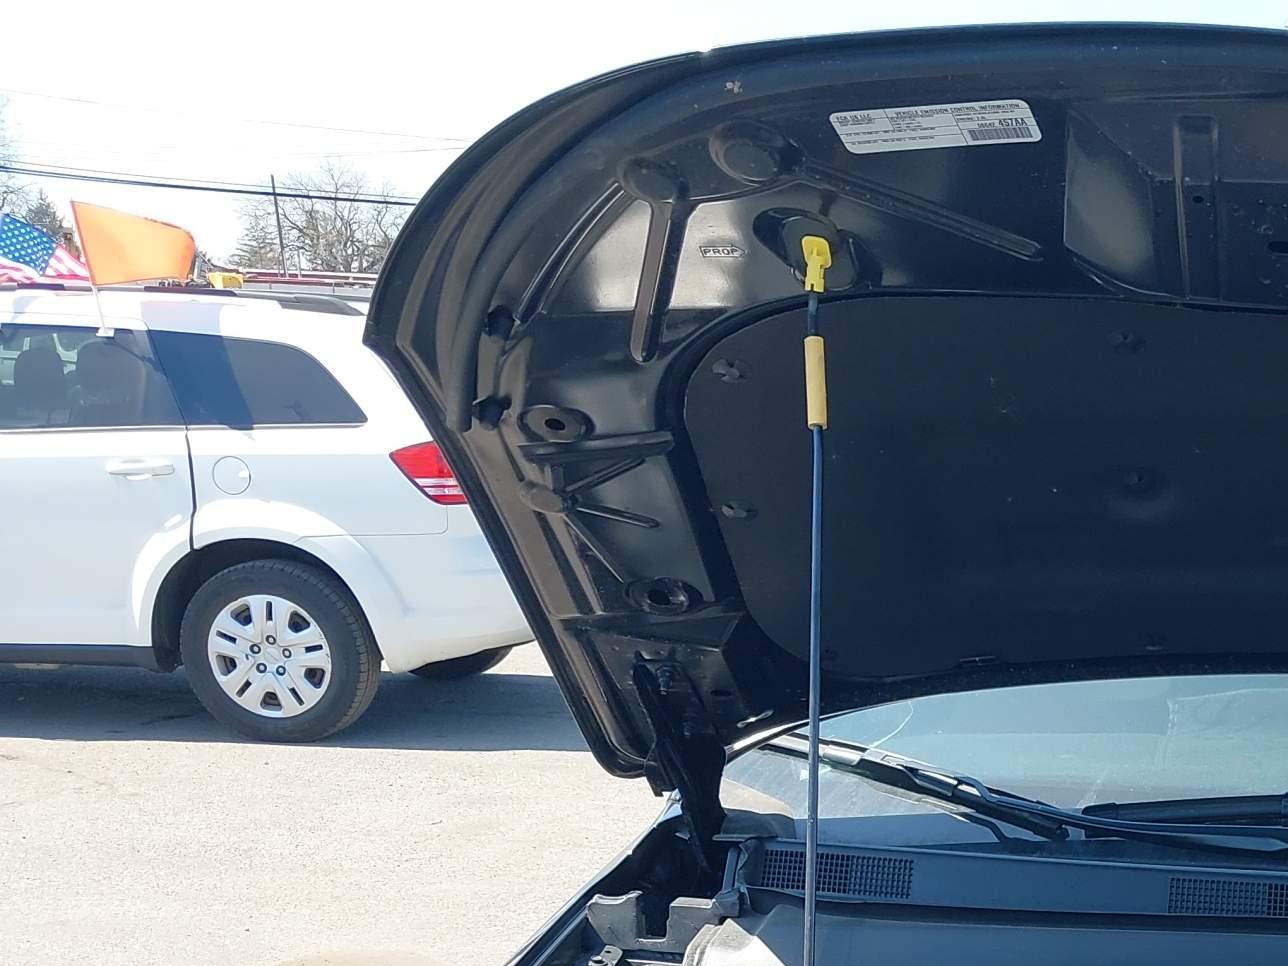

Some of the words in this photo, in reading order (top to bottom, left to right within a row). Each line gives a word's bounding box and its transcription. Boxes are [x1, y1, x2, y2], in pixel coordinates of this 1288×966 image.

[920, 107, 949, 116] EMISSION
[949, 105, 977, 114] CONTROL
[977, 103, 1020, 111] INFORMATION
[998, 117, 1028, 127] 457AA
[703, 248, 738, 256] PROP
